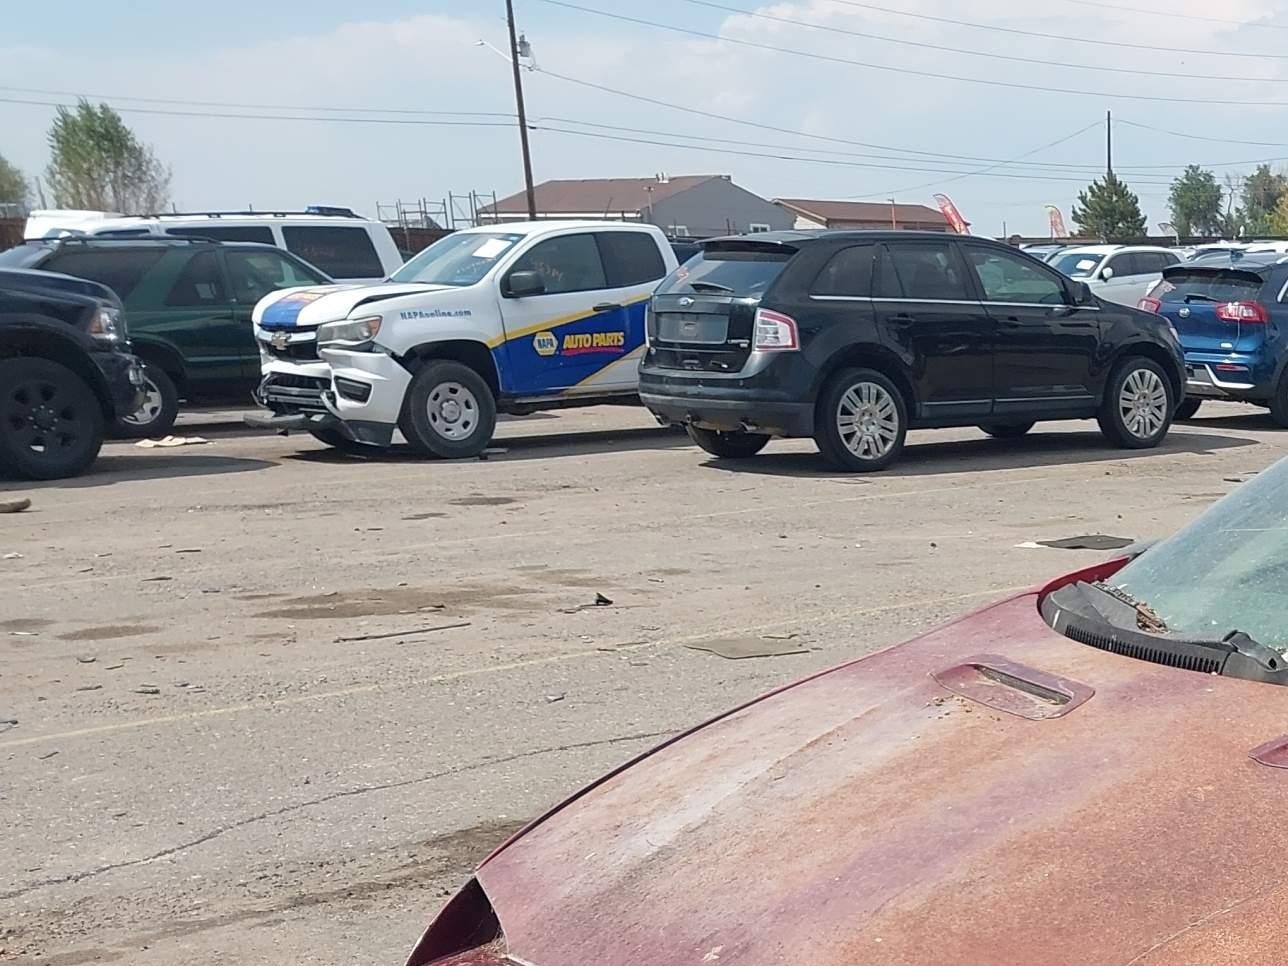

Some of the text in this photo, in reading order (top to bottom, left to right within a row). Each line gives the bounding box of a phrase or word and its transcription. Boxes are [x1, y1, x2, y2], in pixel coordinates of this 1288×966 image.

[537, 331, 625, 350] NAPA AUTO PARTS
